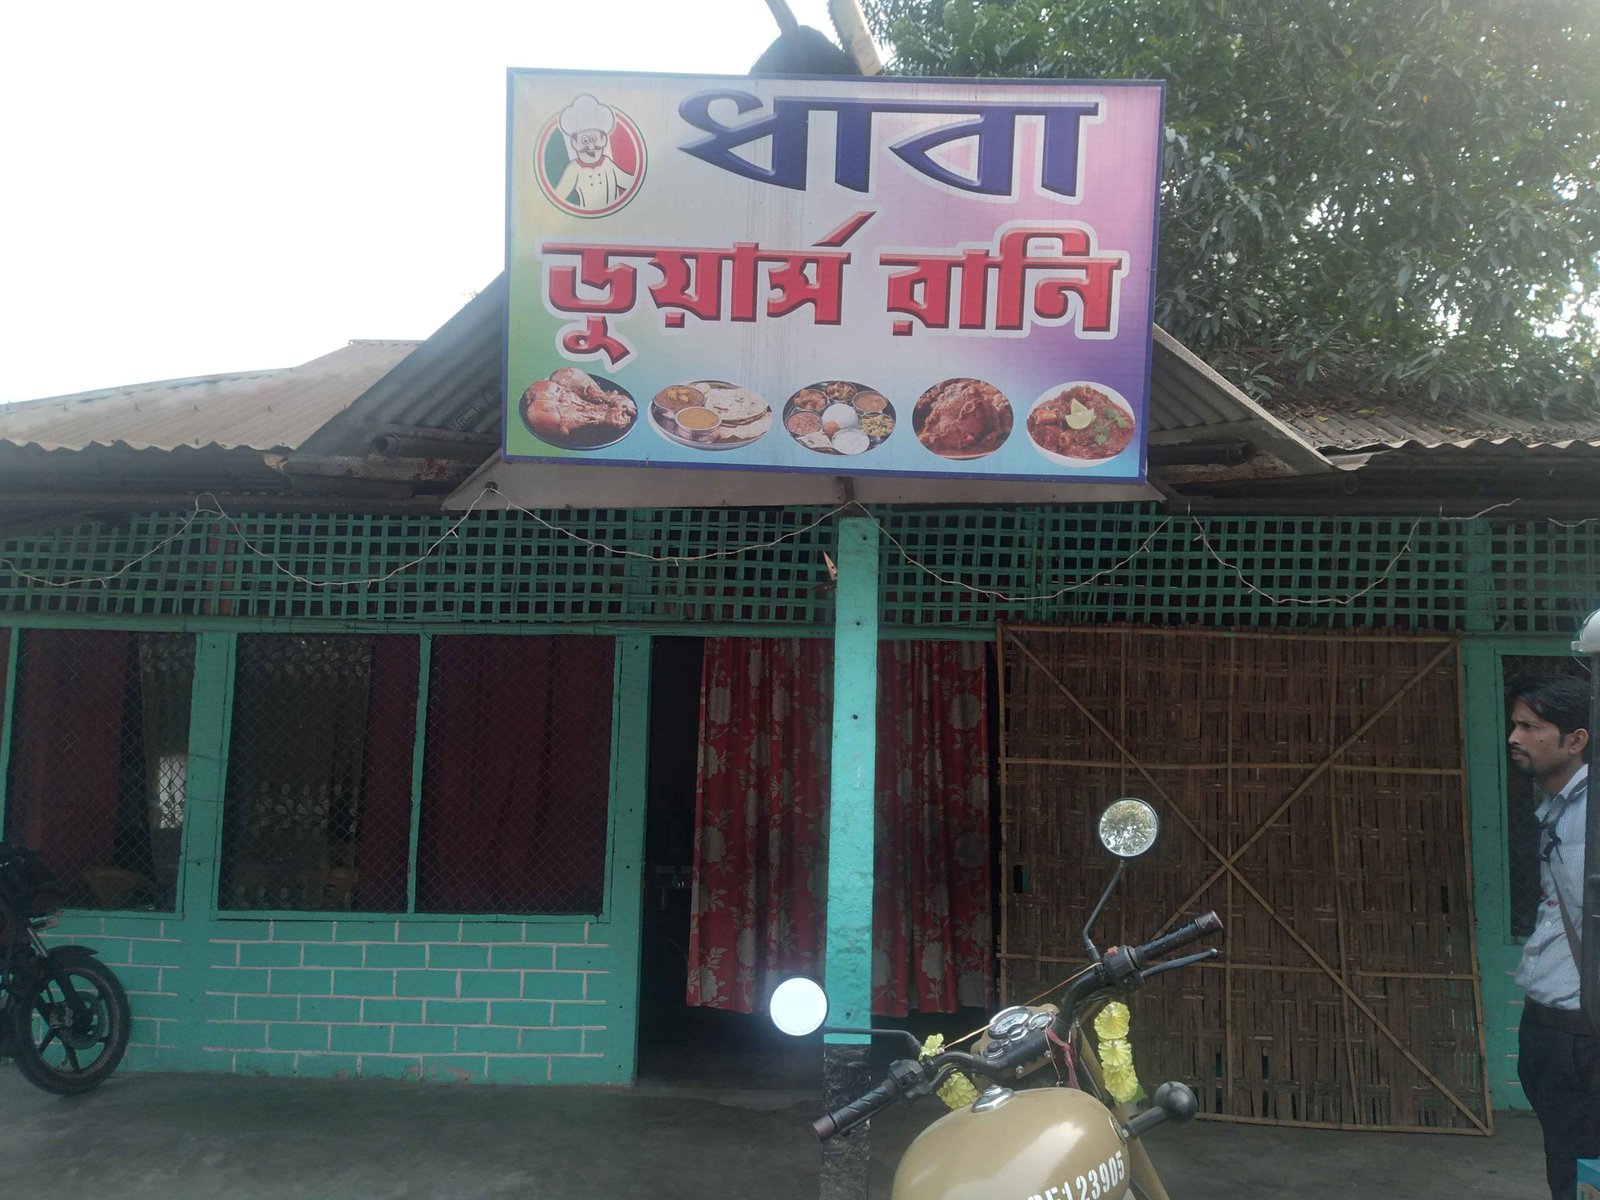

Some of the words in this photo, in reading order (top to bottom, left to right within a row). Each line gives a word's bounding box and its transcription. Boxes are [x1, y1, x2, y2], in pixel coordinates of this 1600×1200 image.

[677, 88, 1099, 197] ধাবা
[541, 211, 877, 365] ডুয়ার্স
[879, 227, 1122, 337] রানি
[1027, 1150, 1124, 1200] 123905
